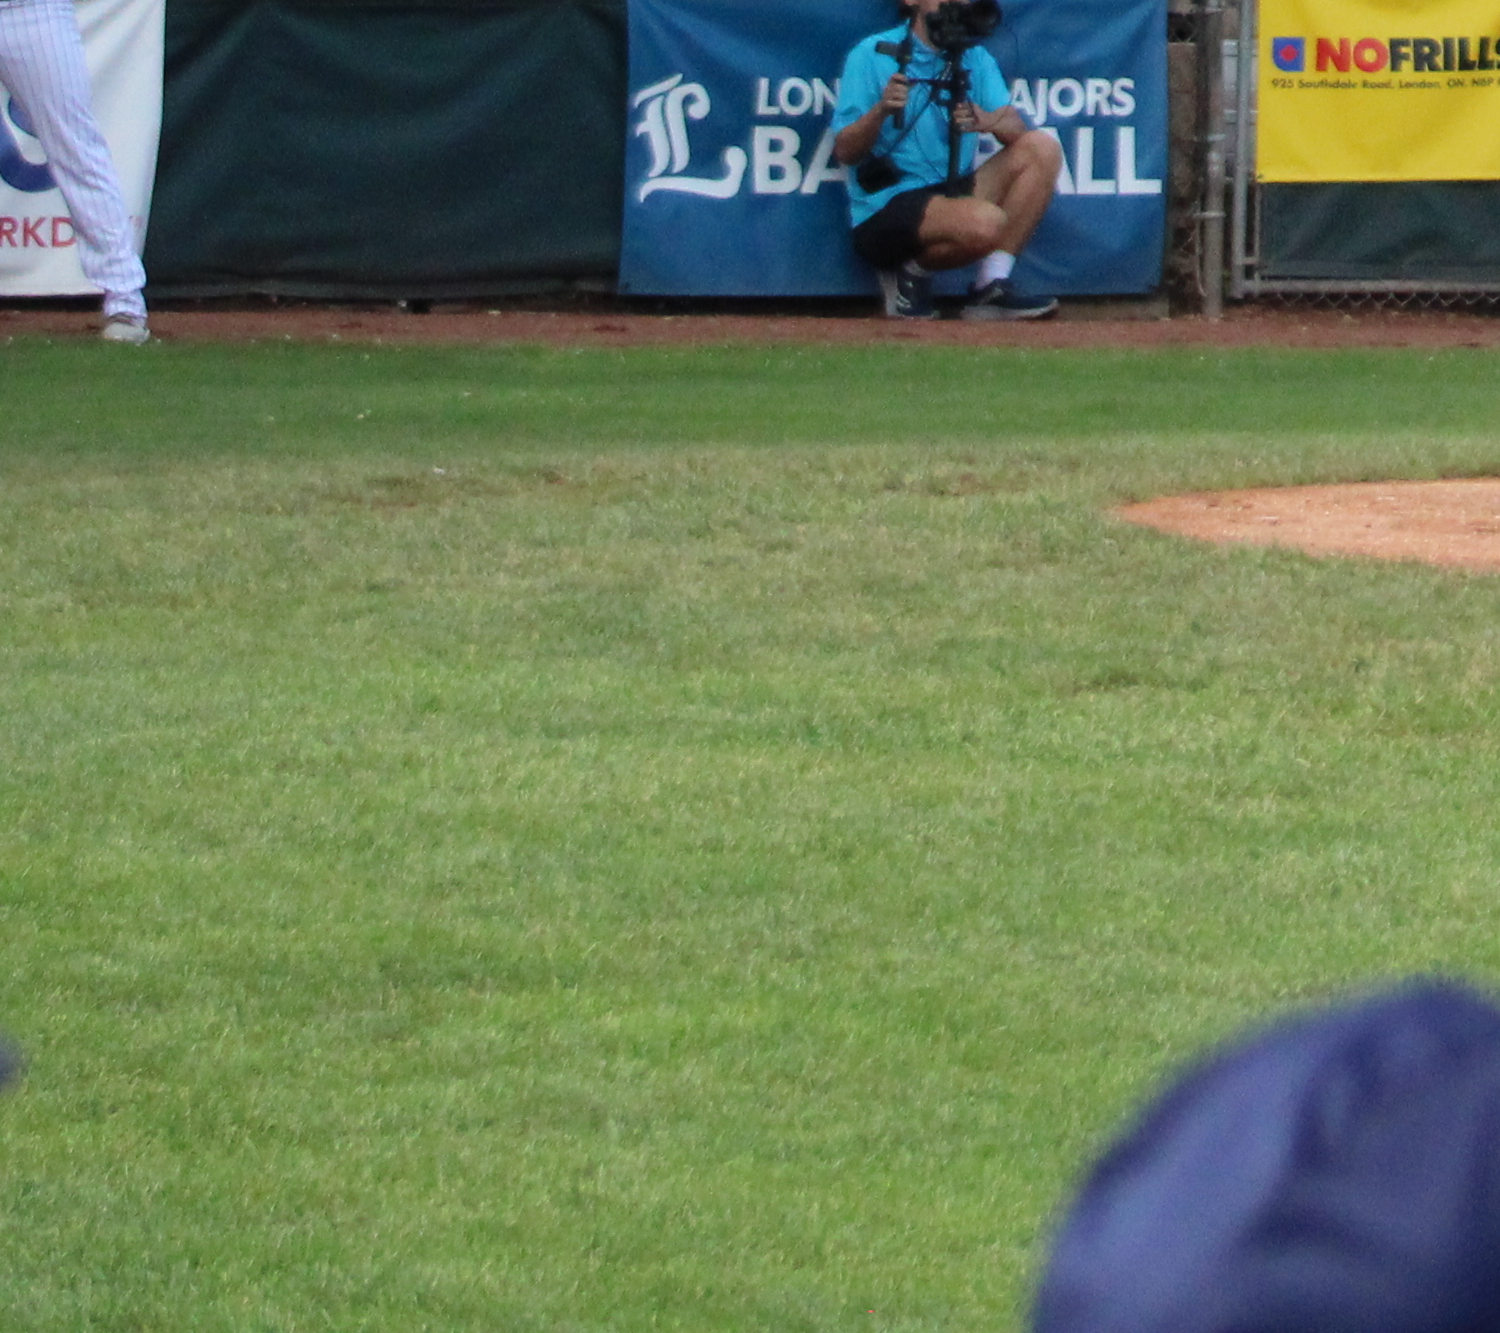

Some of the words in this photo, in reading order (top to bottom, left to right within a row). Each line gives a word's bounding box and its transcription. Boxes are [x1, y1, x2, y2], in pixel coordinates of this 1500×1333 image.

[1271, 78, 1294, 89] 925
[1298, 78, 1358, 90] Southdale
[756, 76, 838, 116] LON
[1010, 77, 1136, 130] AJORS
